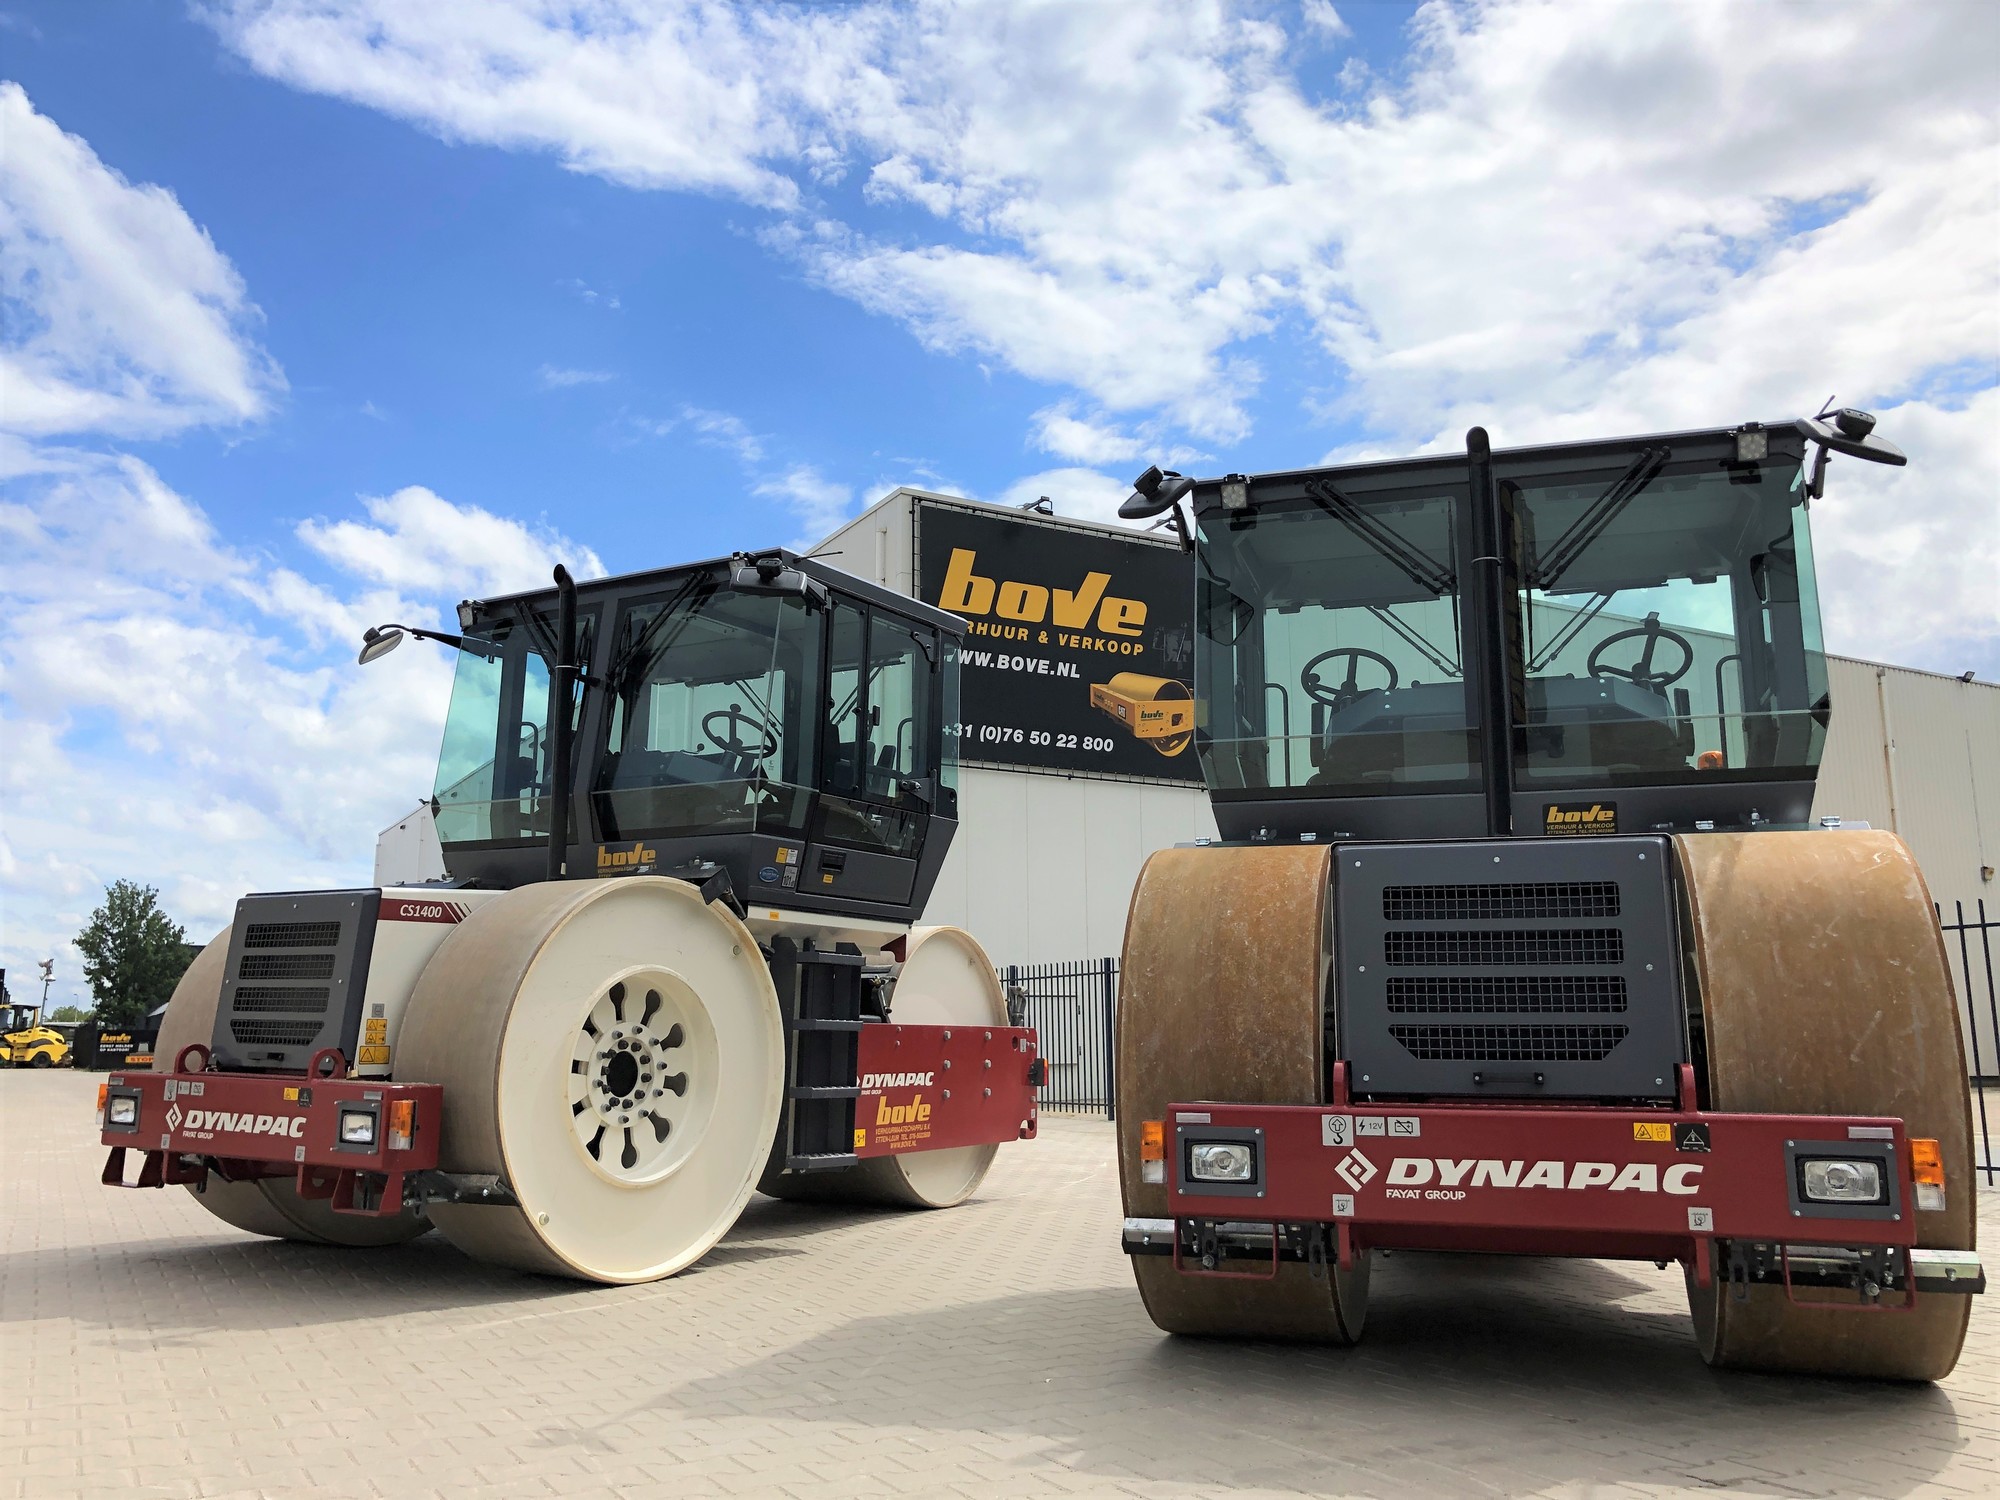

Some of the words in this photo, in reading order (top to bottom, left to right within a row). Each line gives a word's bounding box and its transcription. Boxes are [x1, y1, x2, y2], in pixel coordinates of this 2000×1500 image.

[938, 547, 1148, 637] bove
[966, 620, 1028, 641] RHUUR
[1038, 630, 1048, 644] &
[1058, 633, 1144, 656] VERKOOP
[957, 649, 1081, 679] WW.BOVE.NL
[942, 722, 973, 738] +31
[980, 725, 1024, 743] (0)76
[1029, 730, 1051, 746] 50
[1056, 733, 1078, 749] 22
[1082, 736, 1114, 752] 800
[1547, 805, 1615, 822] bove
[597, 842, 657, 868] bove
[400, 904, 442, 918] CS1400
[861, 1071, 935, 1089] DYNAPAC
[876, 1094, 931, 1126] bove
[182, 1130, 197, 1139] FAYAT
[197, 1131, 214, 1140] GROUP
[184, 1110, 307, 1138] DYNAPAC
[1369, 1122, 1383, 1130] 12V
[1385, 1157, 1704, 1195] DYNAPAC
[1386, 1188, 1421, 1199] FAYAT
[1425, 1189, 1466, 1200] GROUP
